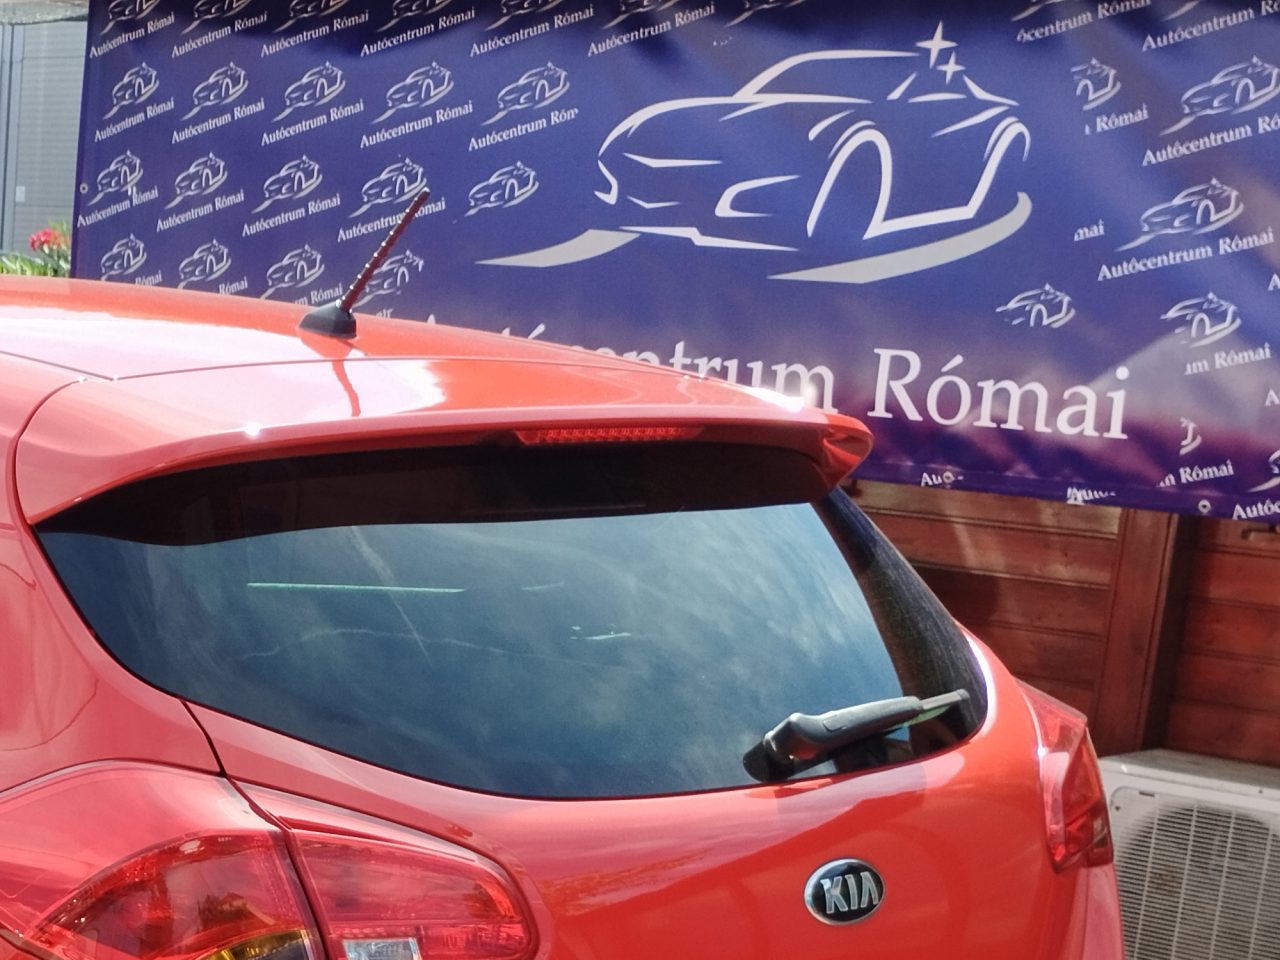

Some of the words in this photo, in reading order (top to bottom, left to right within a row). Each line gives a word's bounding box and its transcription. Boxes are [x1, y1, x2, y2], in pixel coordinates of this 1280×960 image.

[172, 25, 231, 59] Autócentrum
[234, 11, 267, 33] Római
[260, 25, 330, 58] Autócentrum
[333, 10, 369, 32] Római
[360, 24, 435, 57] Autócentrum
[438, 7, 475, 29] Római
[470, 22, 551, 57] Autócentrum
[554, 5, 594, 28] Római
[588, 21, 672, 57] Autócentrum
[674, 2, 716, 27] Római
[1142, 7, 1255, 52] Autócentrum
[172, 111, 231, 144] Autócentrum
[233, 97, 265, 121] Római
[261, 113, 328, 147] Autócentrum
[330, 98, 365, 122] Római
[360, 114, 433, 149] Autócentrum
[436, 100, 473, 123] Római
[468, 117, 548, 152] Autócentrum
[1095, 103, 1149, 134] Római
[1141, 124, 1253, 167] Autócentrum
[242, 208, 306, 238] Autócentrum
[308, 193, 341, 215] Római
[1097, 244, 1213, 282] Autócentrum
[1218, 226, 1275, 255] Római
[1214, 341, 1272, 369] Római
[867, 348, 1130, 440] Római
[1179, 459, 1235, 485] Római
[820, 871, 879, 914] KIA
